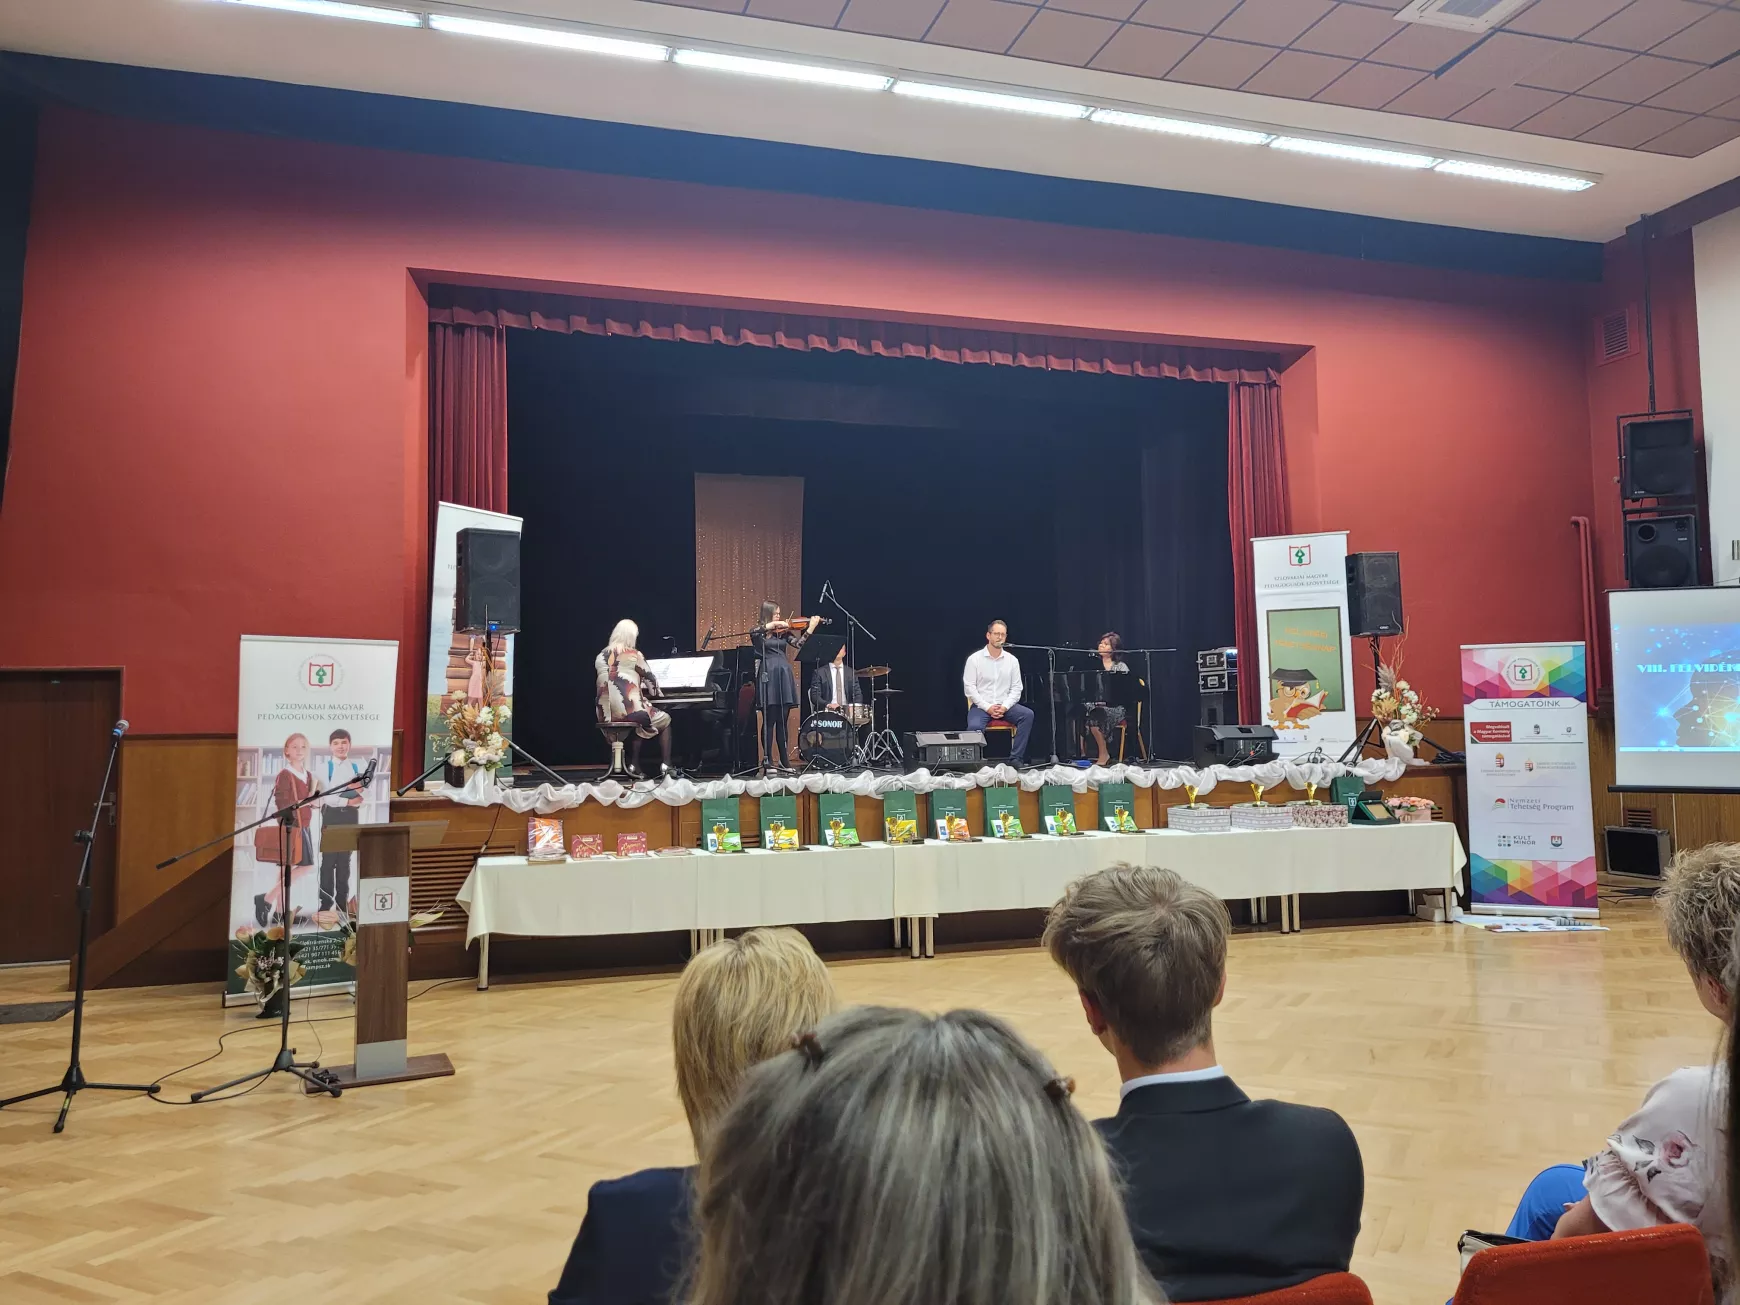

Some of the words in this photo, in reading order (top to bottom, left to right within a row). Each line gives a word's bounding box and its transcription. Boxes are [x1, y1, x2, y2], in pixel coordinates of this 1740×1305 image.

[1636, 663, 1667, 673] VIII.
[328, 703, 365, 711] MAGYAR
[817, 720, 843, 728] SONOR
[1510, 803, 1541, 811] Tehetség
[1542, 803, 1574, 811] Program
